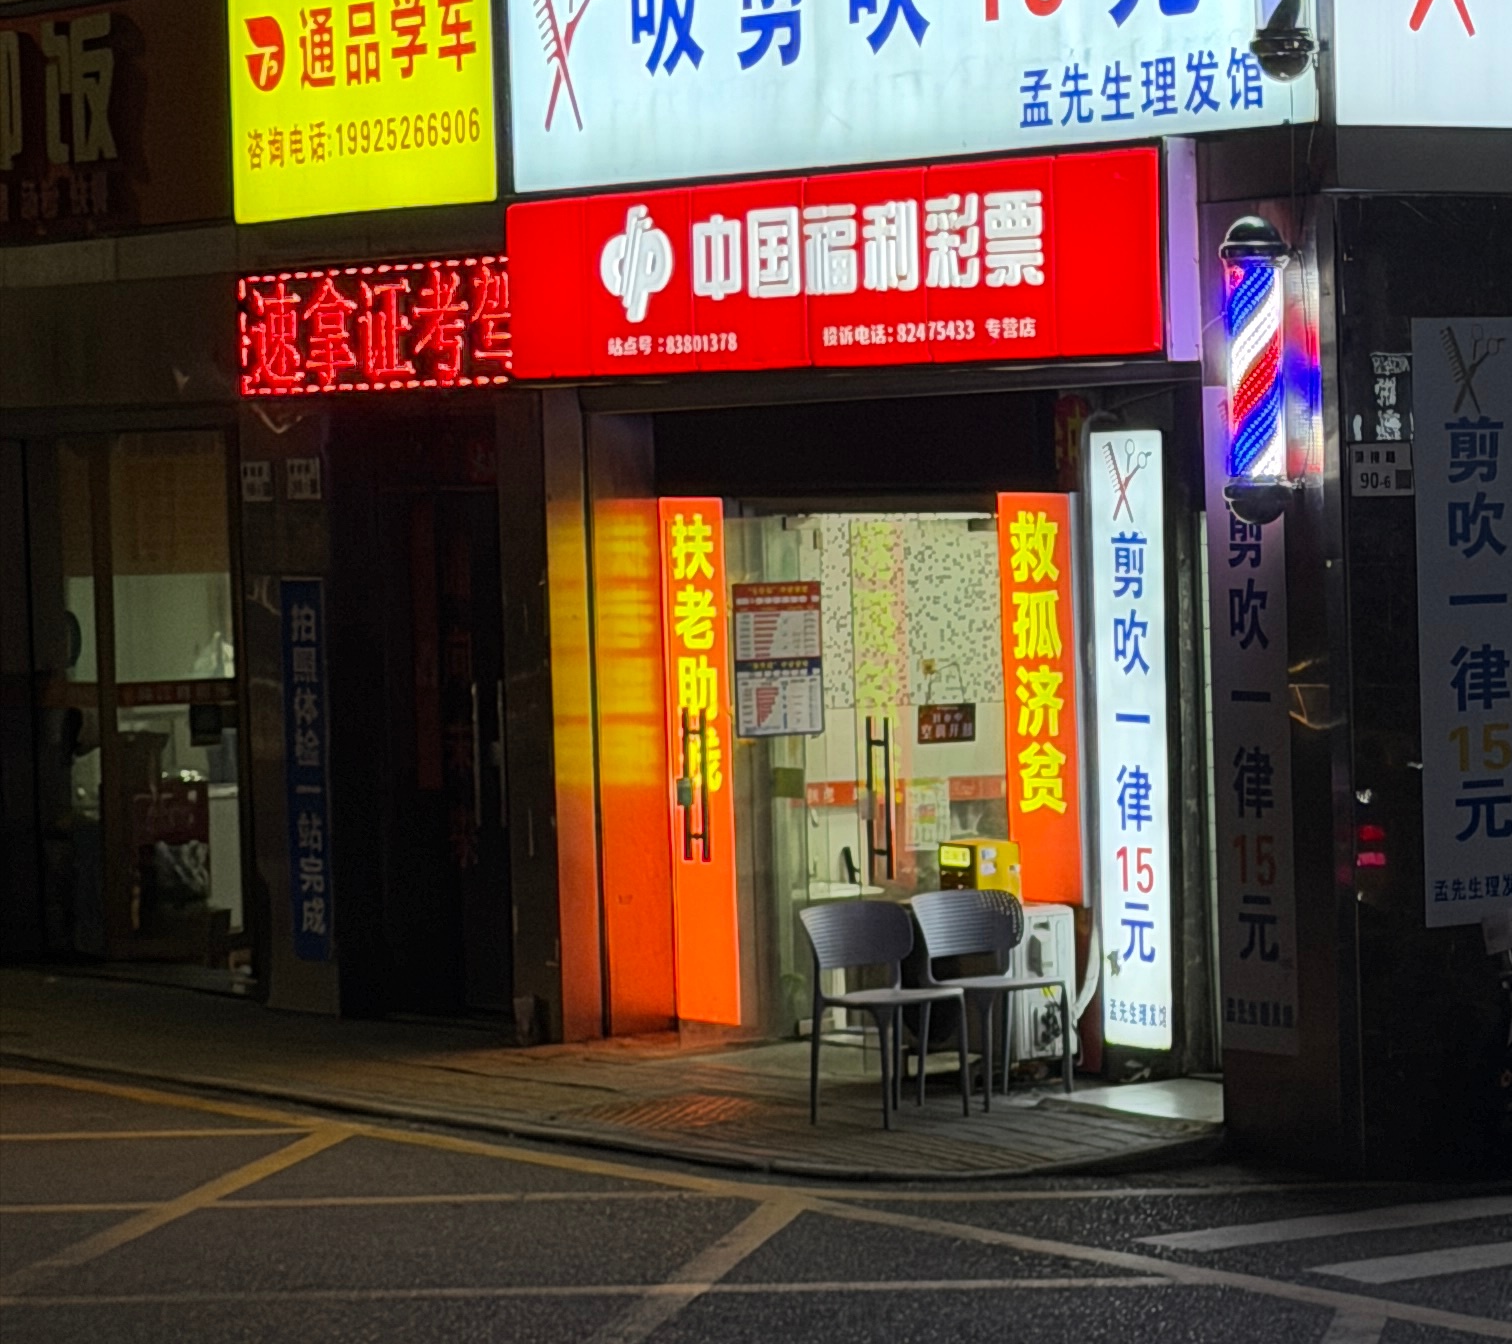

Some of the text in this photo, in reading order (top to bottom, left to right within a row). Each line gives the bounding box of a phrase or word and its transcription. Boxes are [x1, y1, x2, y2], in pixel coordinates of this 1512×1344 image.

[1020, 47, 1264, 128] 孟先生理发馆
[693, 190, 1044, 300] 中国福利彩票
[985, 318, 1036, 340] 专营店
[1010, 511, 1067, 814] 救孤济贫
[1110, 531, 1157, 963] 剪吹一律15元
